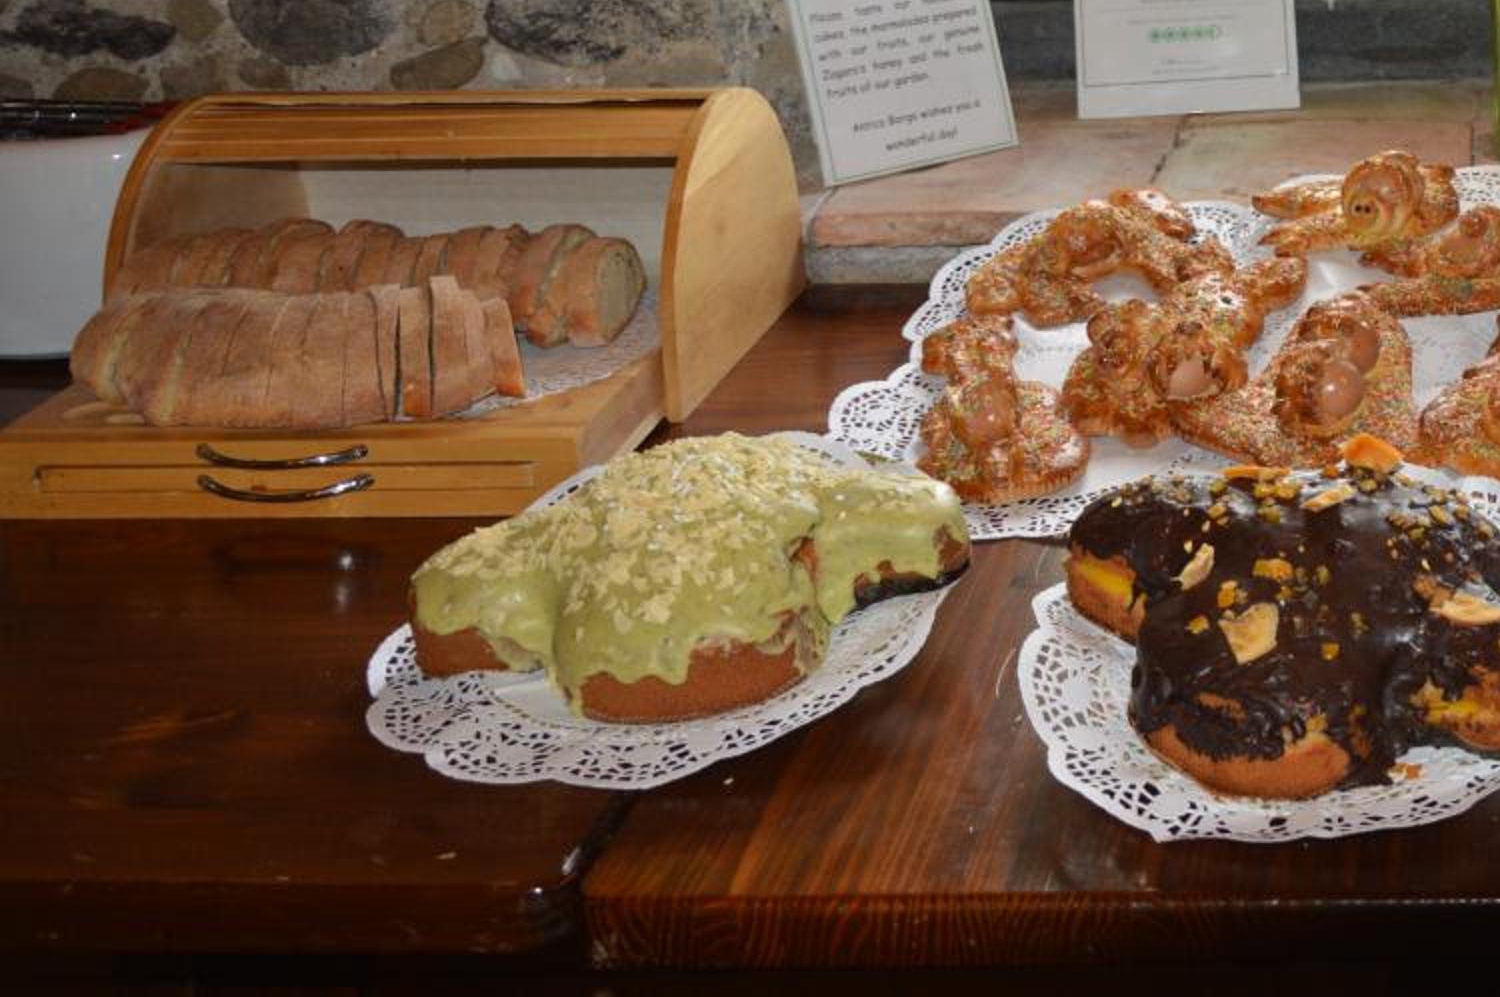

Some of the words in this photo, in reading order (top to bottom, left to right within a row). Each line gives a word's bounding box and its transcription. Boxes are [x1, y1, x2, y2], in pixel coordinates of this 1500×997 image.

[849, 23, 868, 34] the
[871, 15, 930, 32] marmalades
[931, 5, 977, 23] prepared
[893, 0, 912, 10] our
[818, 48, 842, 62] with
[850, 45, 868, 56] our
[918, 33, 935, 43] our
[944, 25, 980, 40] genuine
[872, 58, 903, 72] honey
[908, 52, 927, 64] and
[932, 48, 950, 58] the
[957, 41, 984, 54] fresh
[826, 83, 858, 99] fruits
[859, 79, 872, 92] of
[874, 79, 891, 90] our
[852, 118, 885, 133] Antico
[887, 111, 918, 127] Borgo
[955, 101, 973, 113] you
[885, 131, 936, 152] wonderful
